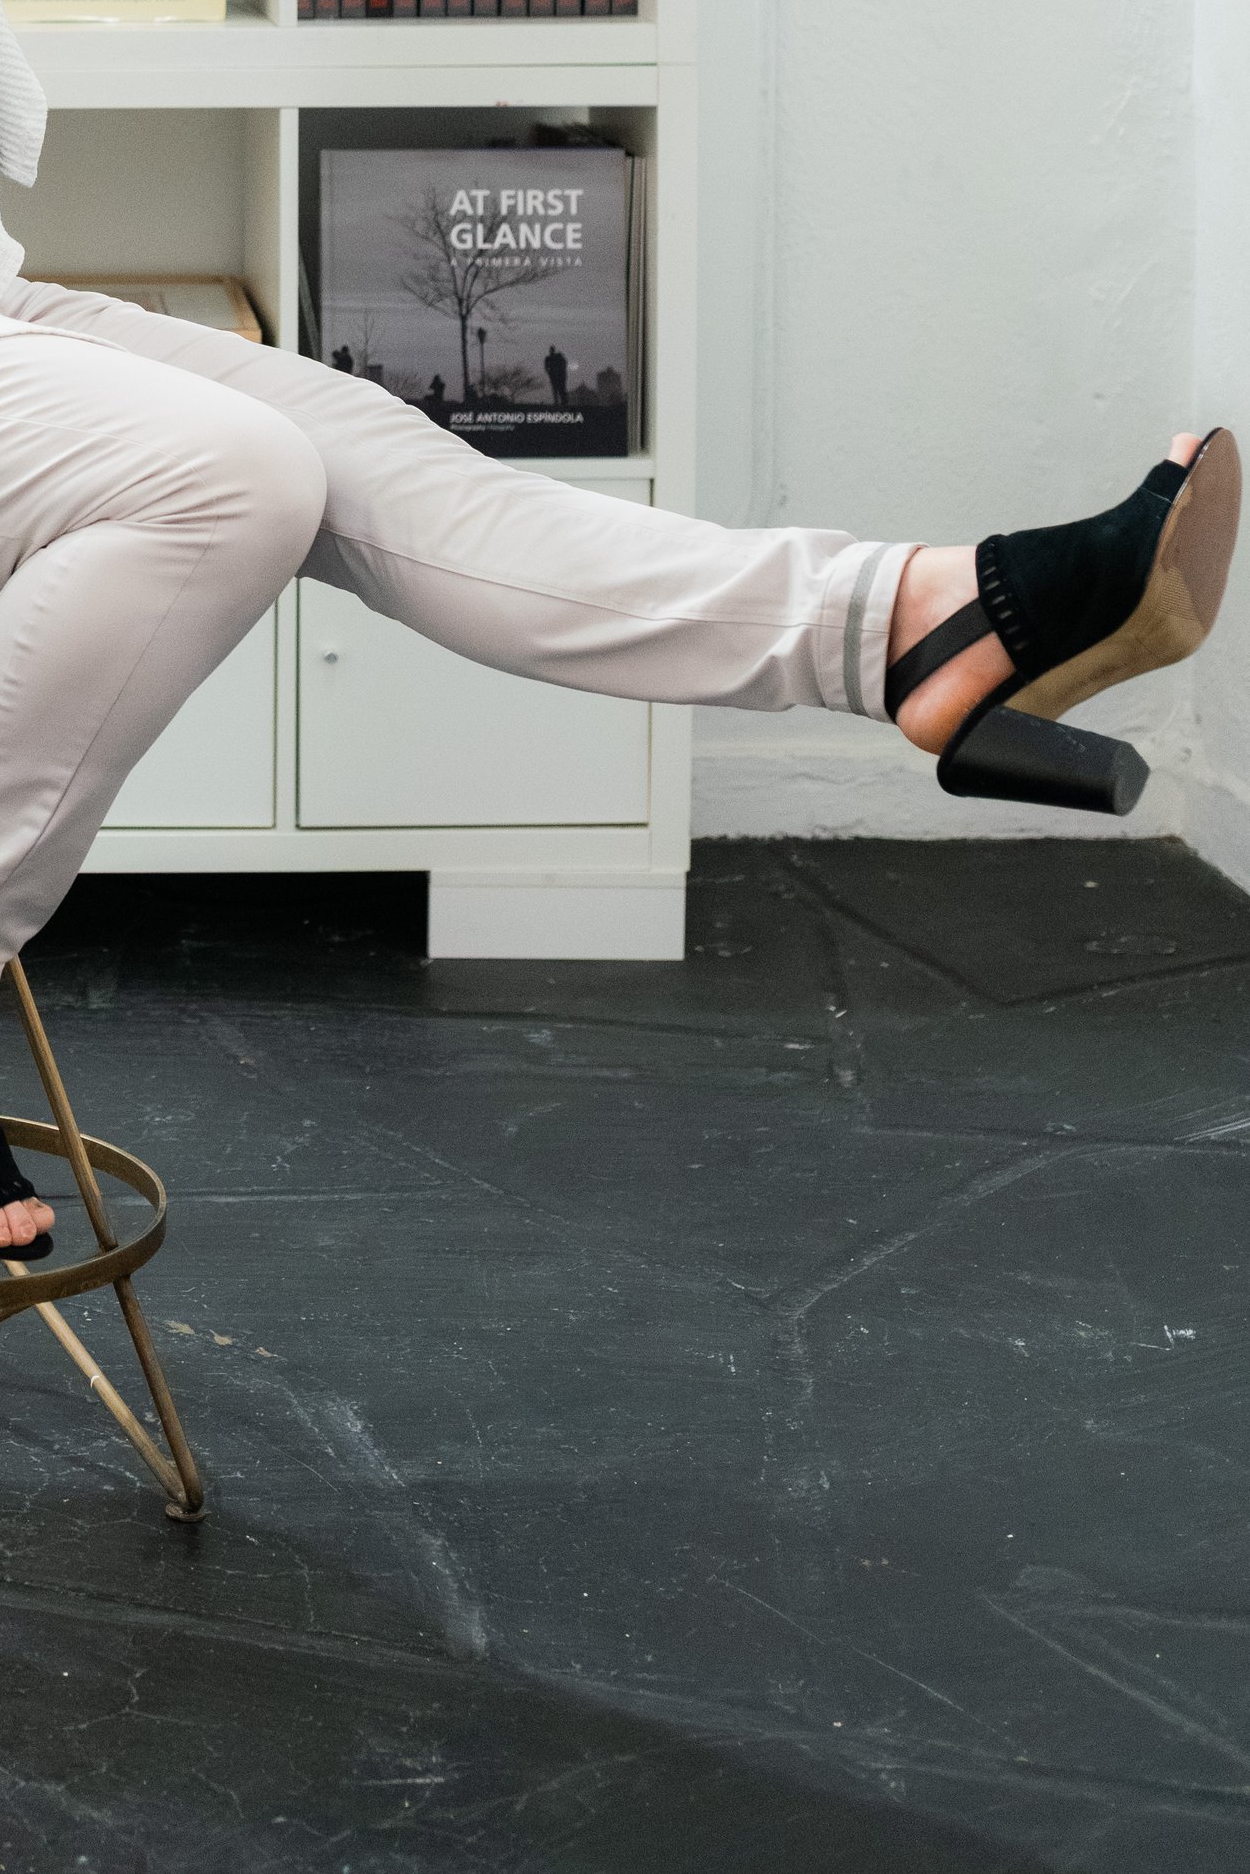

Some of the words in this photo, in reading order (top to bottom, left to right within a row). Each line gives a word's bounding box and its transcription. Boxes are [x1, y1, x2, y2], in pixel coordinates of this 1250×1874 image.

[450, 189, 491, 216] AT
[500, 189, 584, 216] FIRST
[450, 222, 583, 249] GLANCE
[538, 257, 583, 267] VISTA
[450, 411, 474, 424] JOSÉ
[476, 412, 526, 424] ANTONIO
